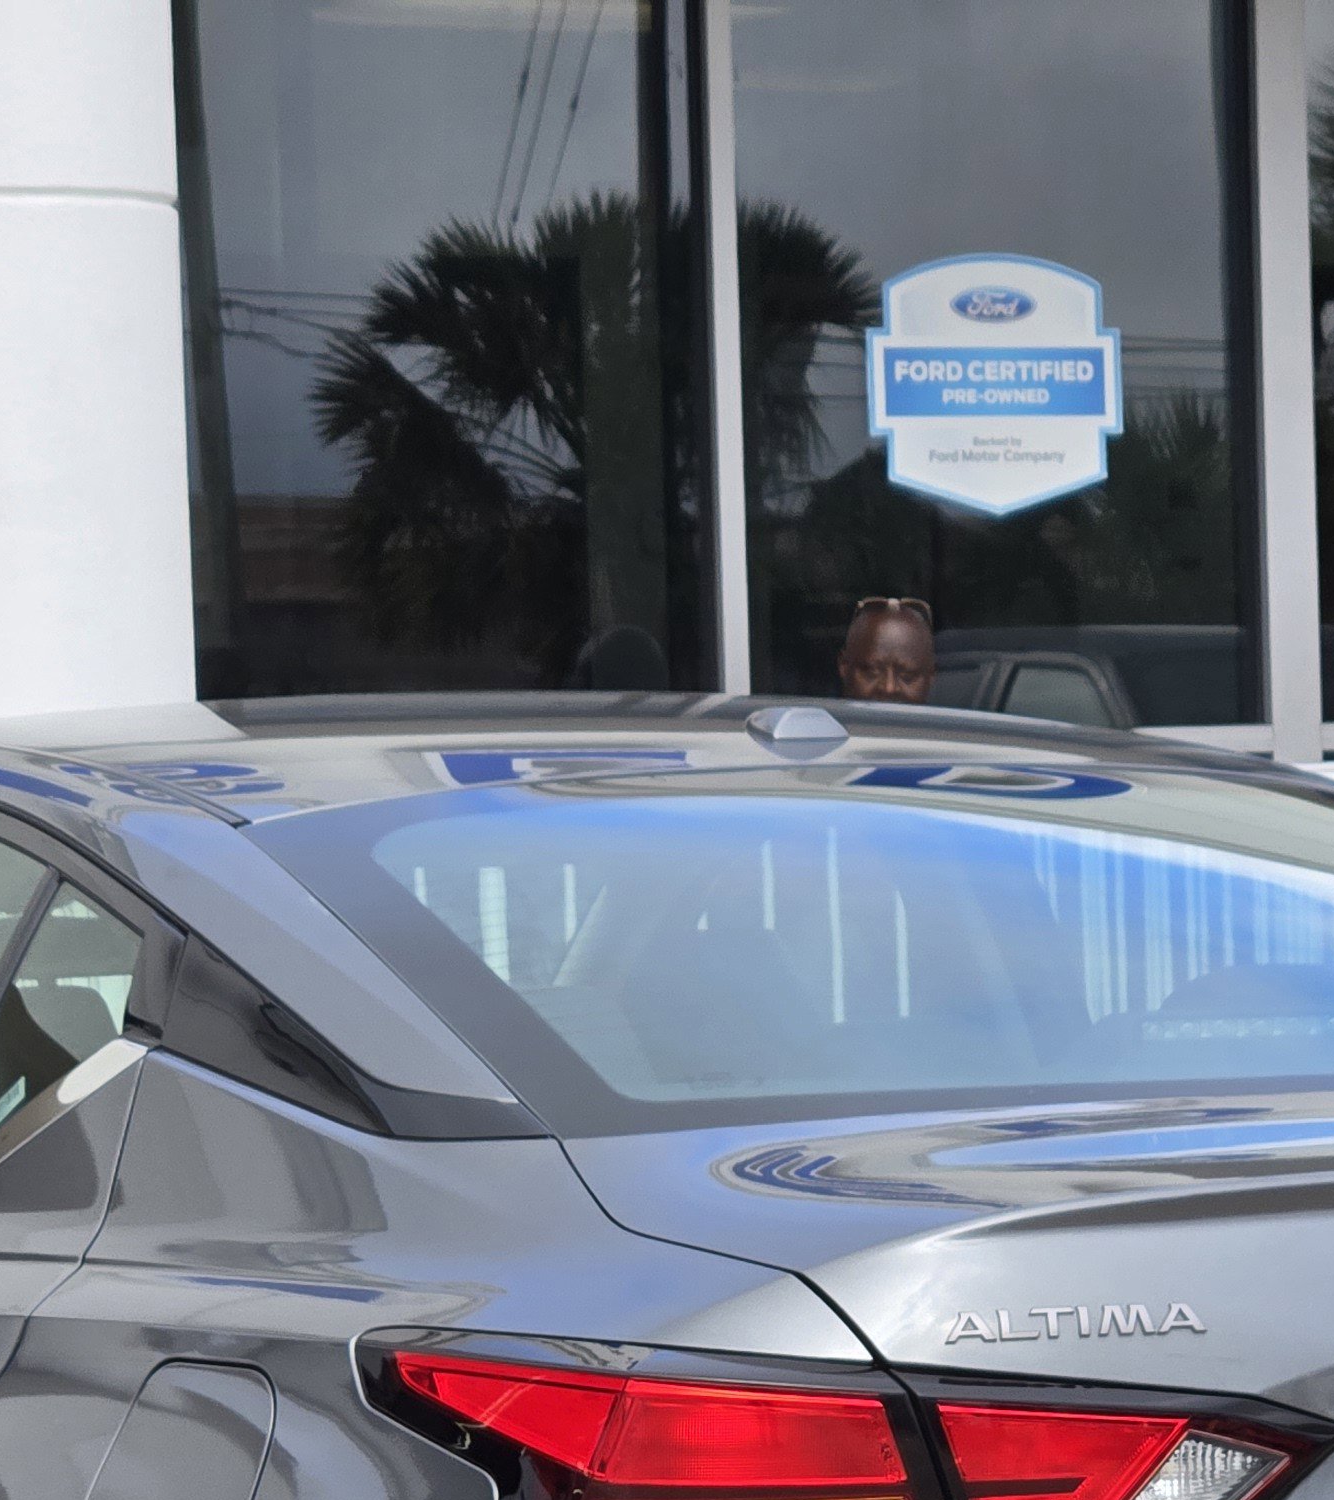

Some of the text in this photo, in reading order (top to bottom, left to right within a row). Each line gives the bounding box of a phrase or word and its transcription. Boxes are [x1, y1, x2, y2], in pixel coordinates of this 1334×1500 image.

[967, 291, 1020, 317] Ford
[894, 360, 1094, 382] FORD CERTIFIED
[942, 388, 1050, 404] PRE-OWNED
[929, 449, 1066, 465] Ford Motor Company
[945, 1301, 1207, 1345] ALTIMA
